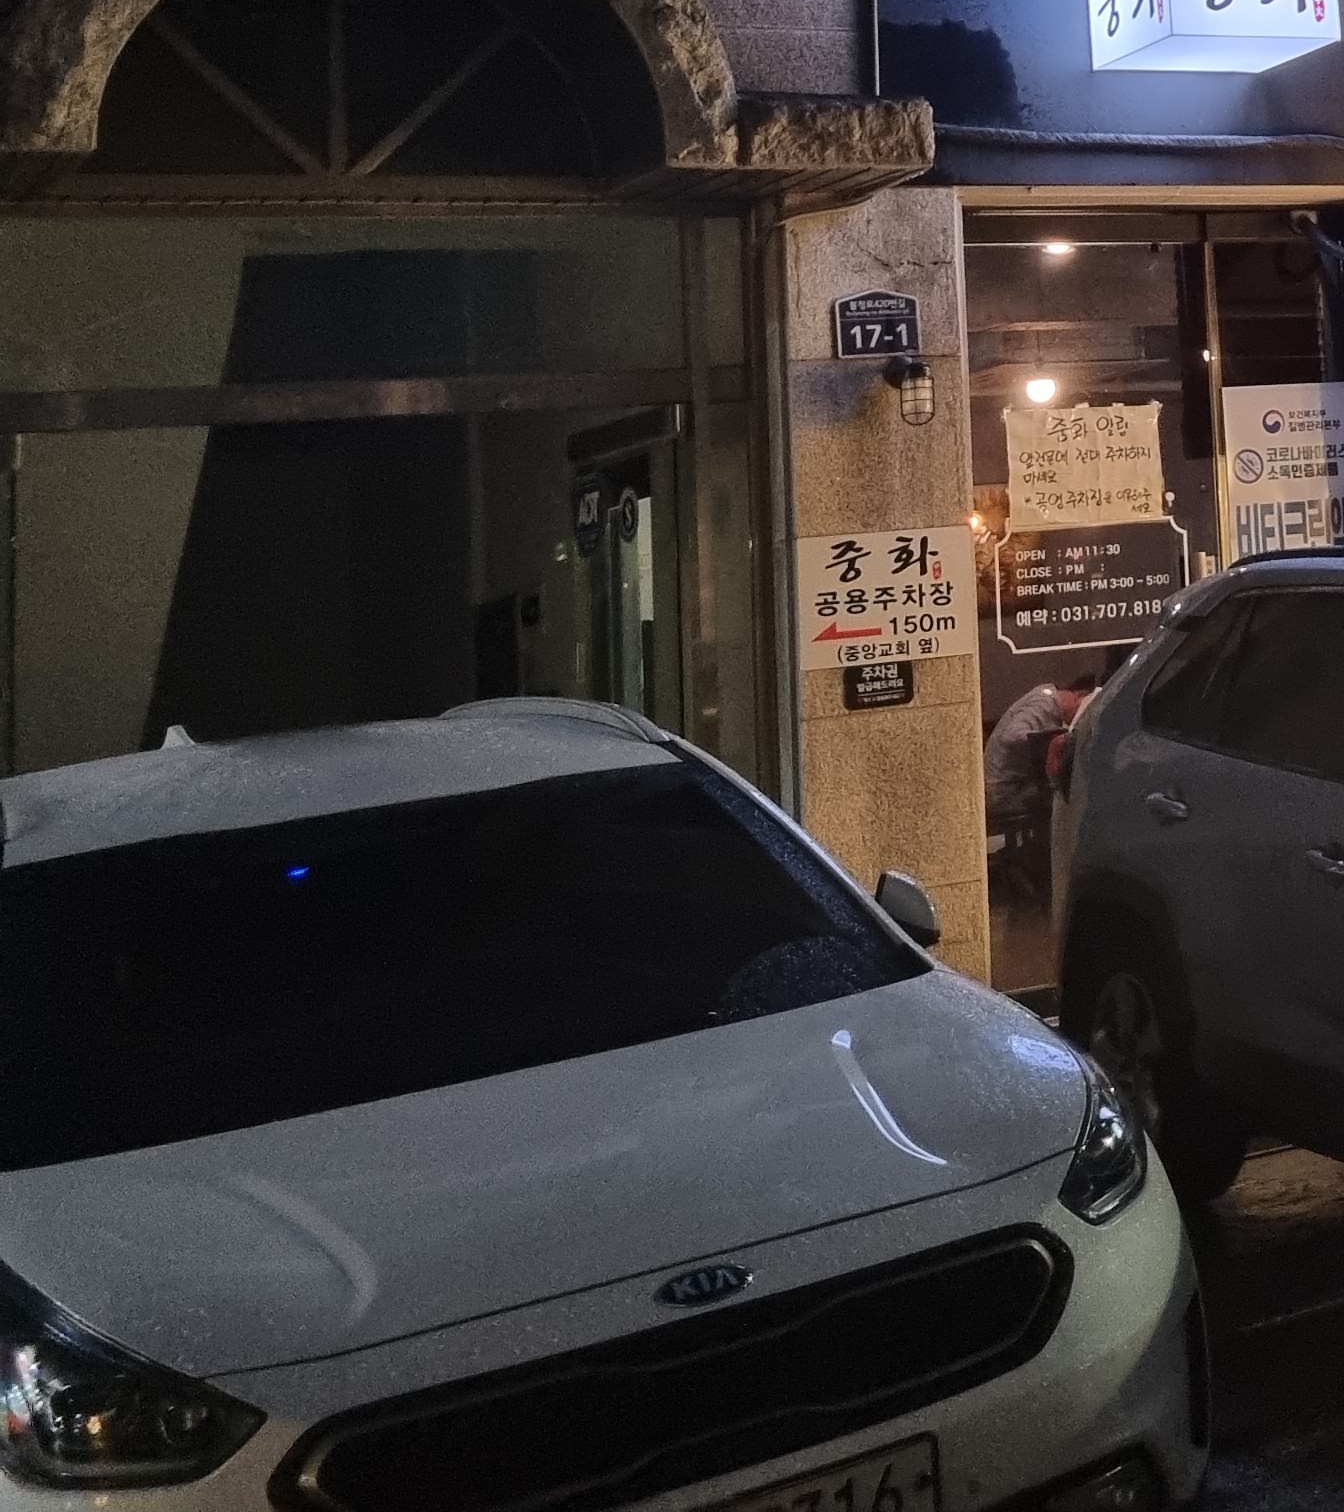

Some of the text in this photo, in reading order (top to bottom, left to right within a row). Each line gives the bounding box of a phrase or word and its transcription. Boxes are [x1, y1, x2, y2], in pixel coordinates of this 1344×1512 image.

[850, 323, 908, 349] 17-1
[1047, 415, 1128, 442] 중화 알림
[1288, 419, 1342, 432] 질병관리본부
[1105, 446, 1151, 462] 주차하지
[1015, 549, 1046, 562] OPEN
[1016, 567, 1052, 580] CLOSE
[815, 581, 953, 616] 공용주차장
[1017, 584, 1055, 597] BREAK
[1061, 599, 1164, 623] 031.707.818
[889, 614, 956, 635] 150m
[862, 663, 898, 680] 주차권
[674, 1268, 739, 1300] KIA
